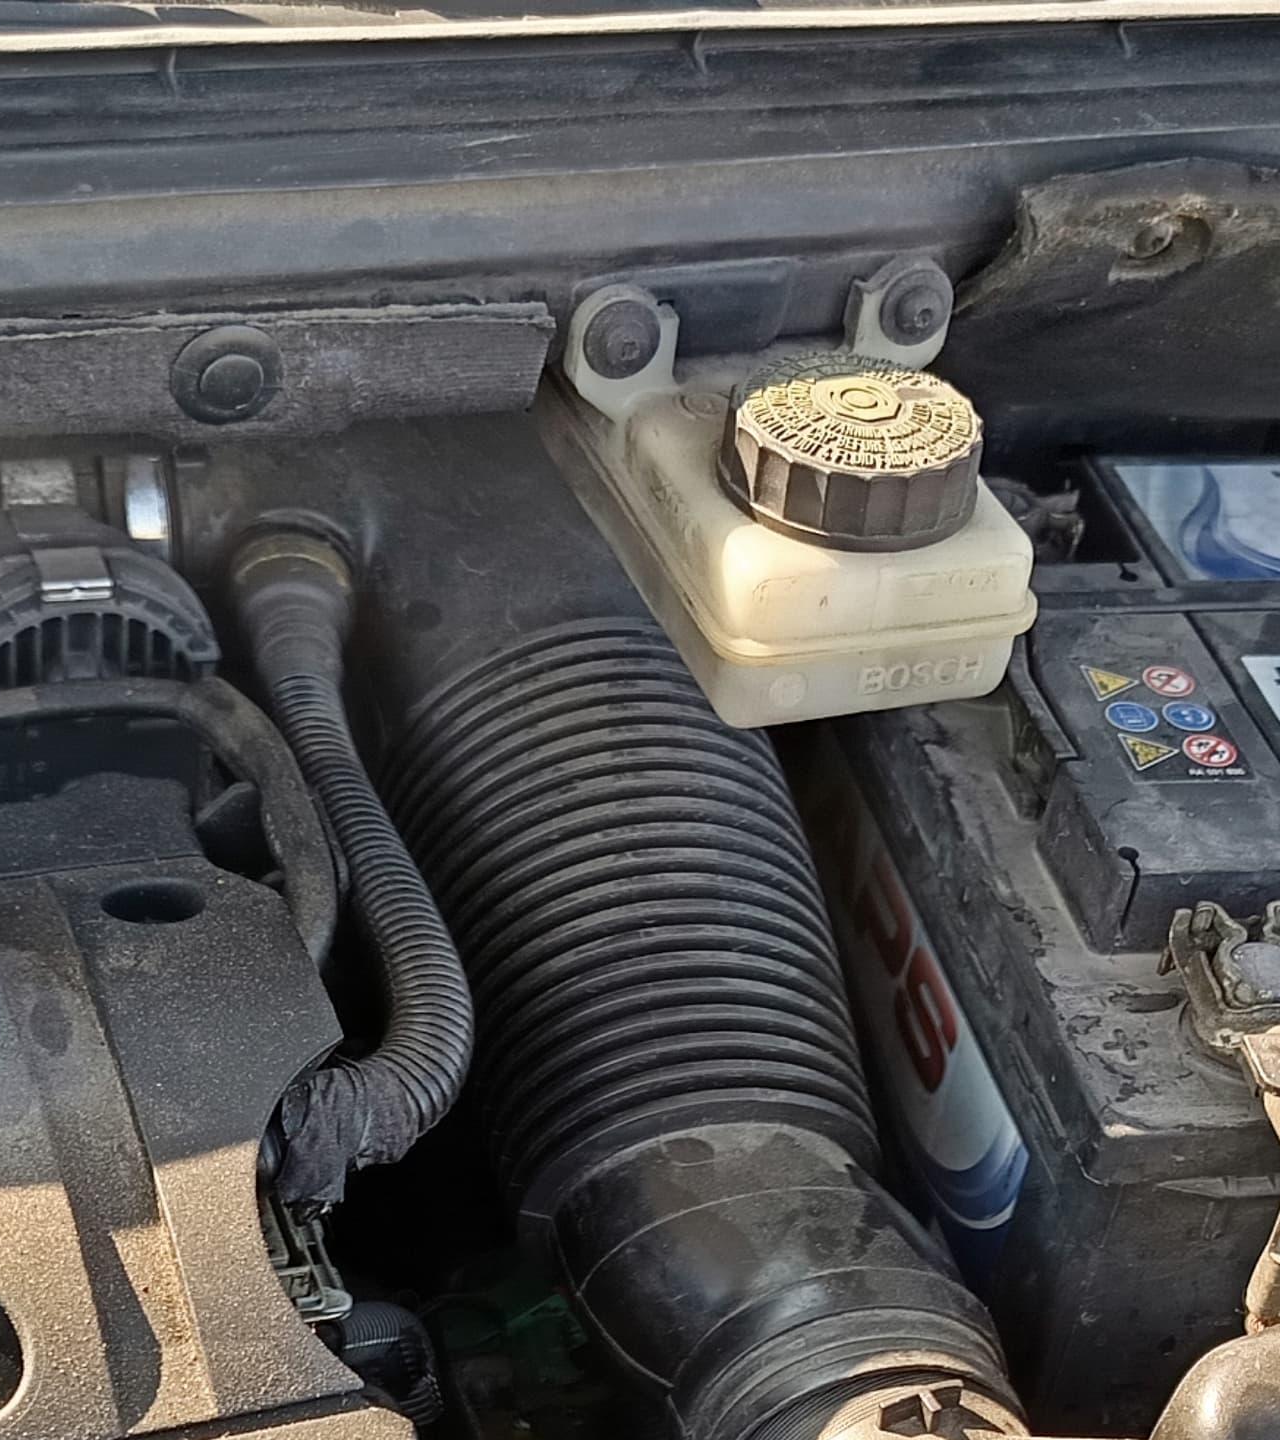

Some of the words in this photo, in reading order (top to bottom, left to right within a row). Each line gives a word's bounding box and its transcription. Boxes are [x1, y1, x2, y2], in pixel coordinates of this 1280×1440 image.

[837, 435, 887, 454] BEFORE
[860, 656, 984, 695] BOSCH
[844, 840, 958, 1092] PS
